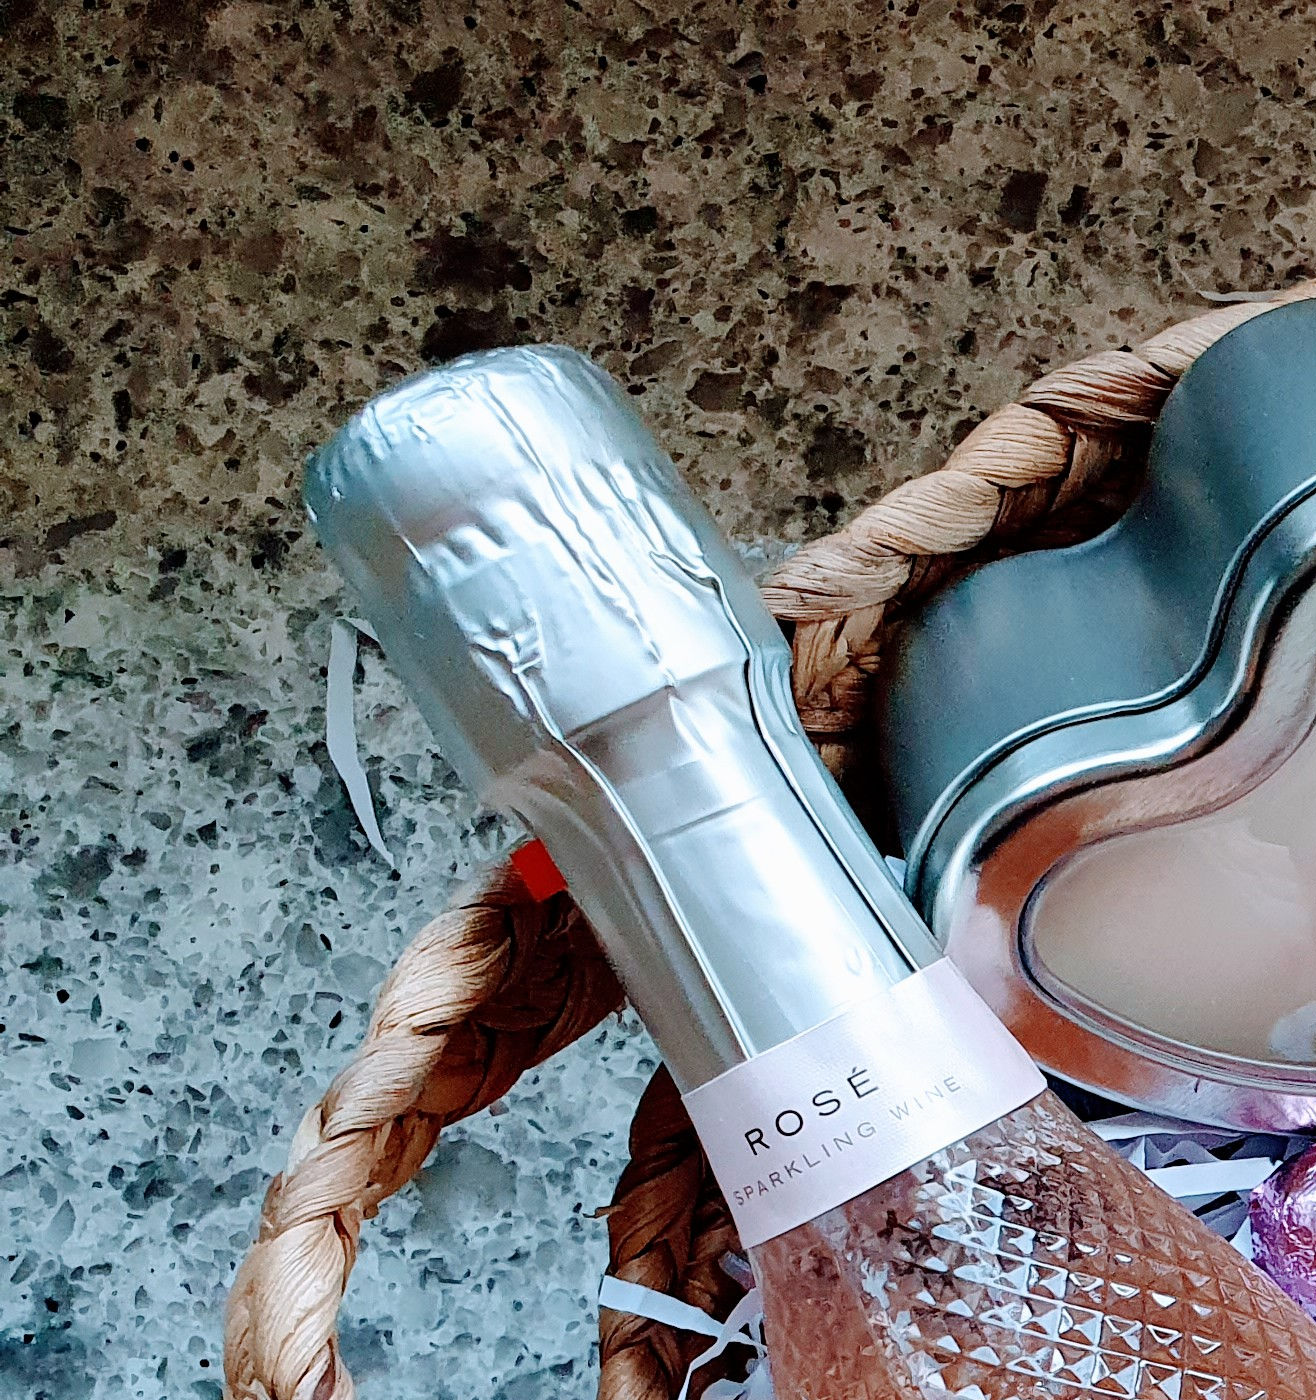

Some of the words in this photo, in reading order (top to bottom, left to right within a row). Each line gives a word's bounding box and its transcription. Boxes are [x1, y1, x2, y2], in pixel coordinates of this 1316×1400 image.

[733, 1121, 876, 1206] SPARKLING
[890, 1076, 962, 1121] WINE
[744, 1067, 879, 1156] ROSÉ
